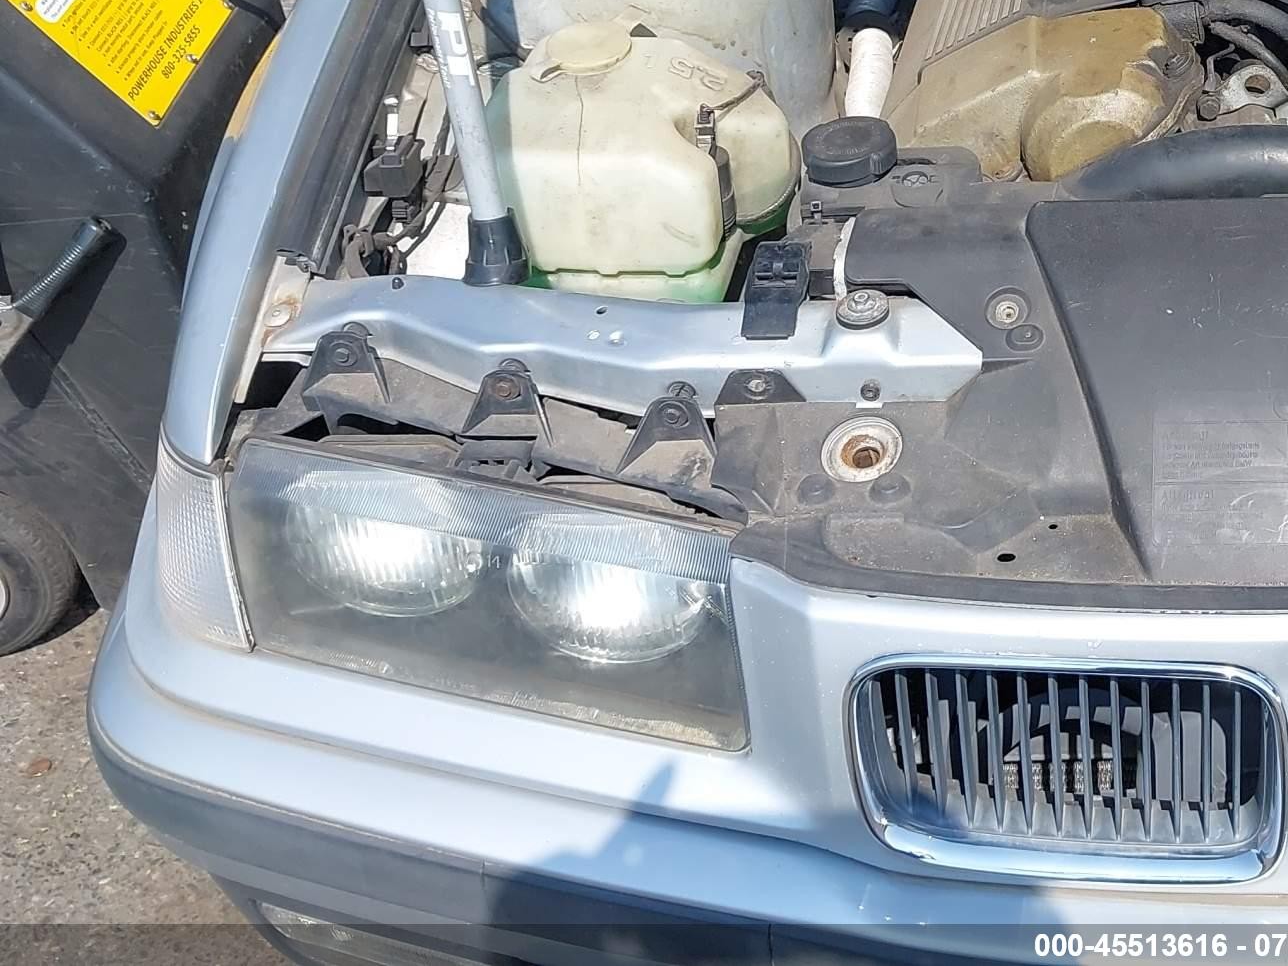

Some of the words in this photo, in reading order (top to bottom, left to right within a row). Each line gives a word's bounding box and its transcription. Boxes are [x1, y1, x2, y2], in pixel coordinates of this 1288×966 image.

[126, 44, 168, 101] POWERHOUSE
[162, 0, 201, 49] INDUSTRIES
[160, 23, 201, 79] 800-325-5855
